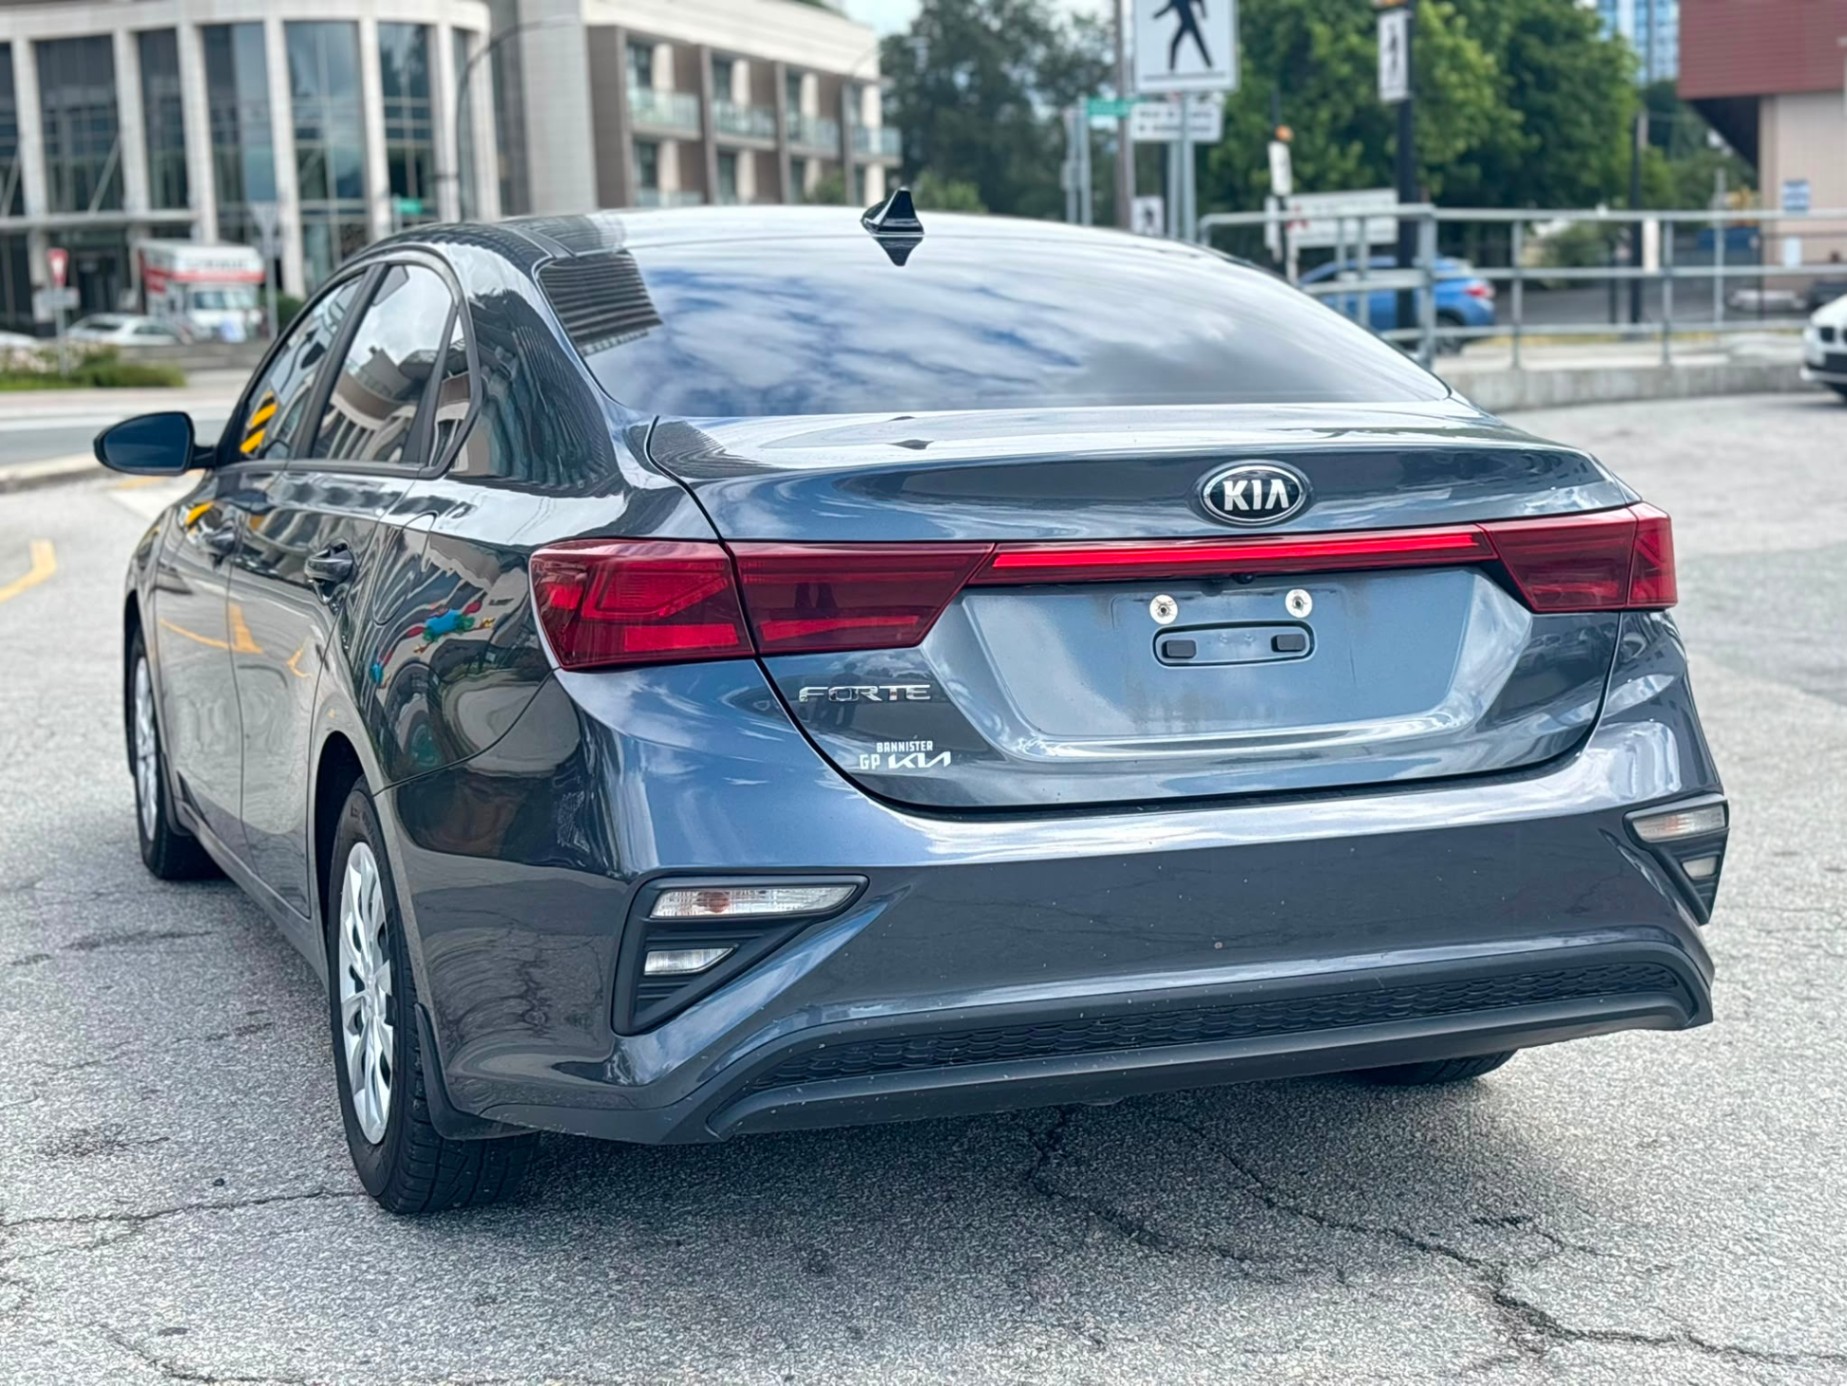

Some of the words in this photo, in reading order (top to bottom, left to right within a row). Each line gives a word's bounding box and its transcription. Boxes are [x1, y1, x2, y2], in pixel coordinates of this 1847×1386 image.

[1222, 478, 1289, 511] KIA
[798, 684, 931, 702] FORTE
[876, 741, 933, 753] BANNISTER
[859, 754, 880, 770] GP
